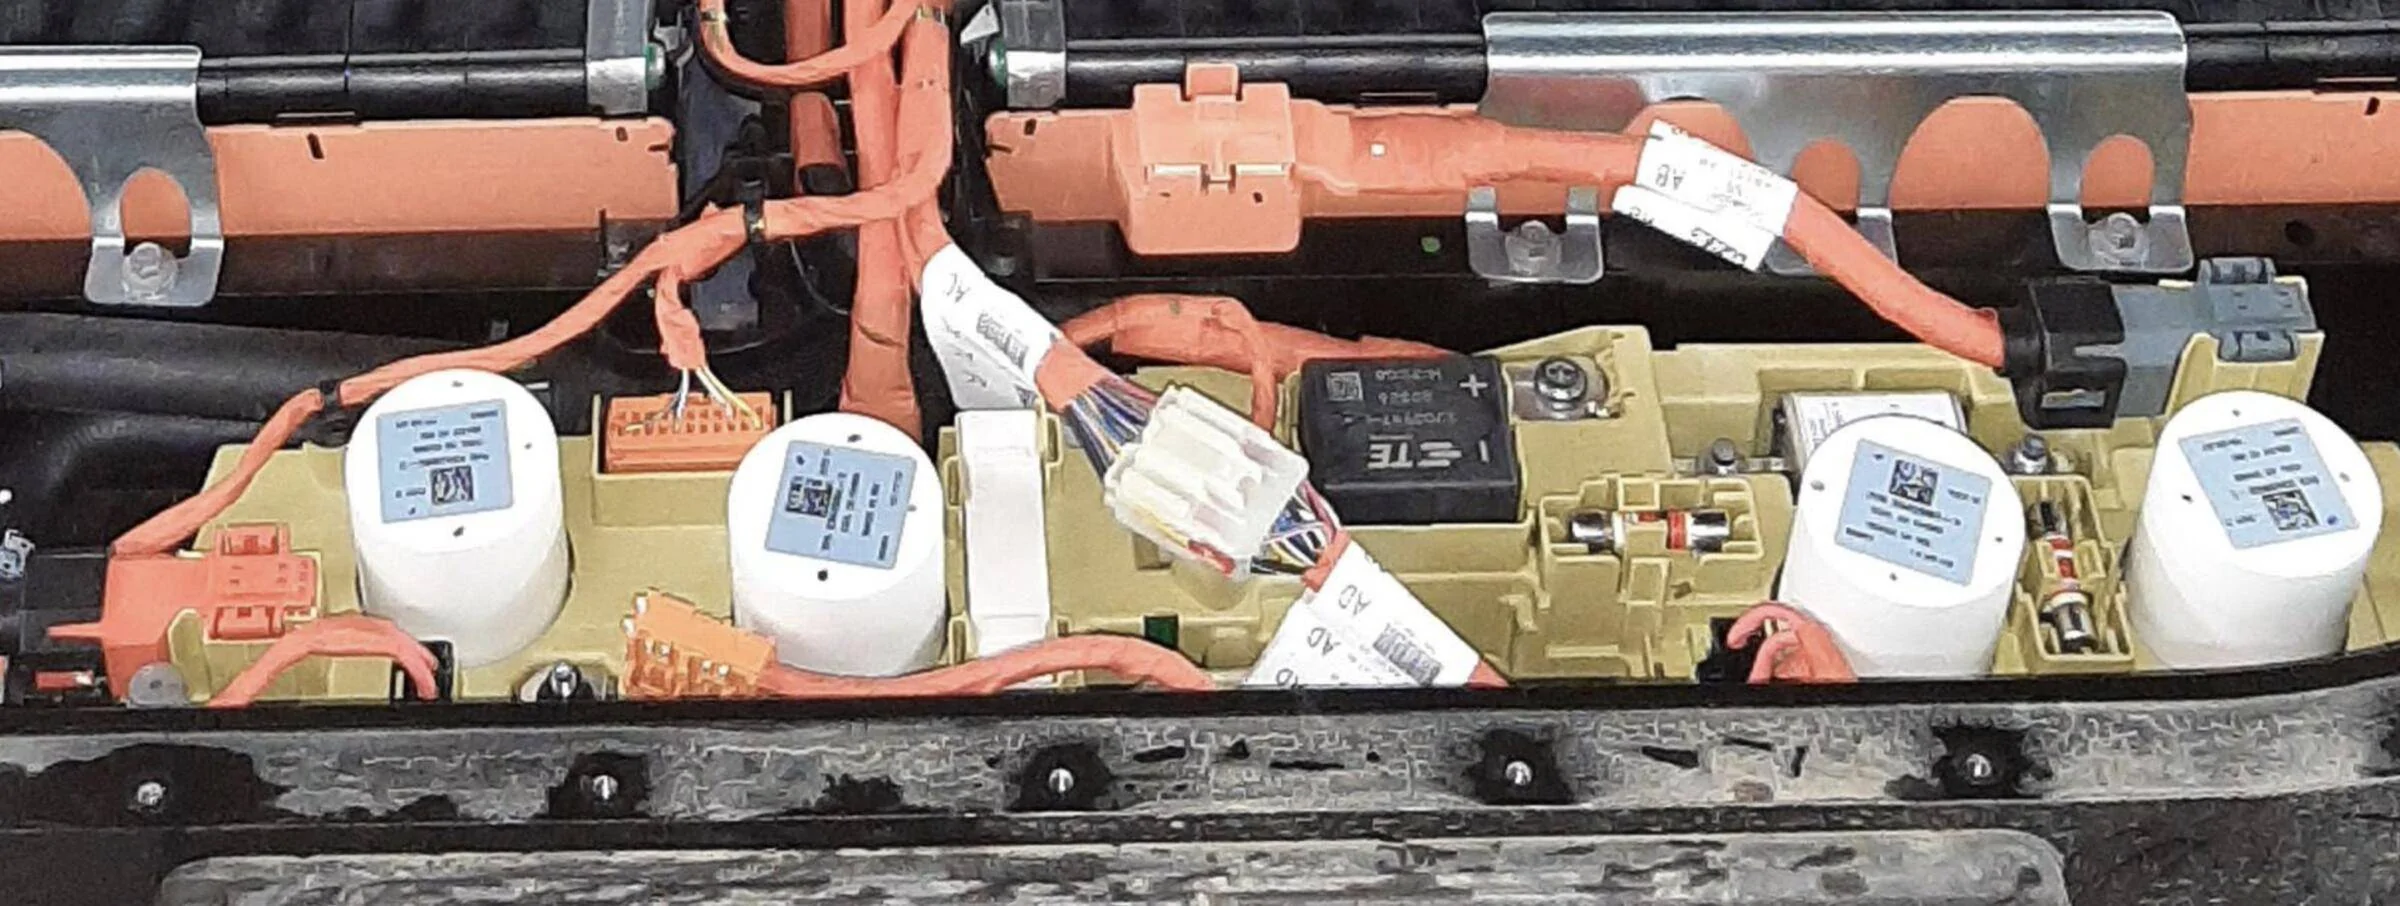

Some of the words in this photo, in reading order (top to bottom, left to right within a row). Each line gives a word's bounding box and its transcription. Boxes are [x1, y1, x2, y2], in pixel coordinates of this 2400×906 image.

[1367, 441, 1413, 470] TE
[1338, 584, 1372, 616] AD
[1306, 627, 1342, 656] AD
